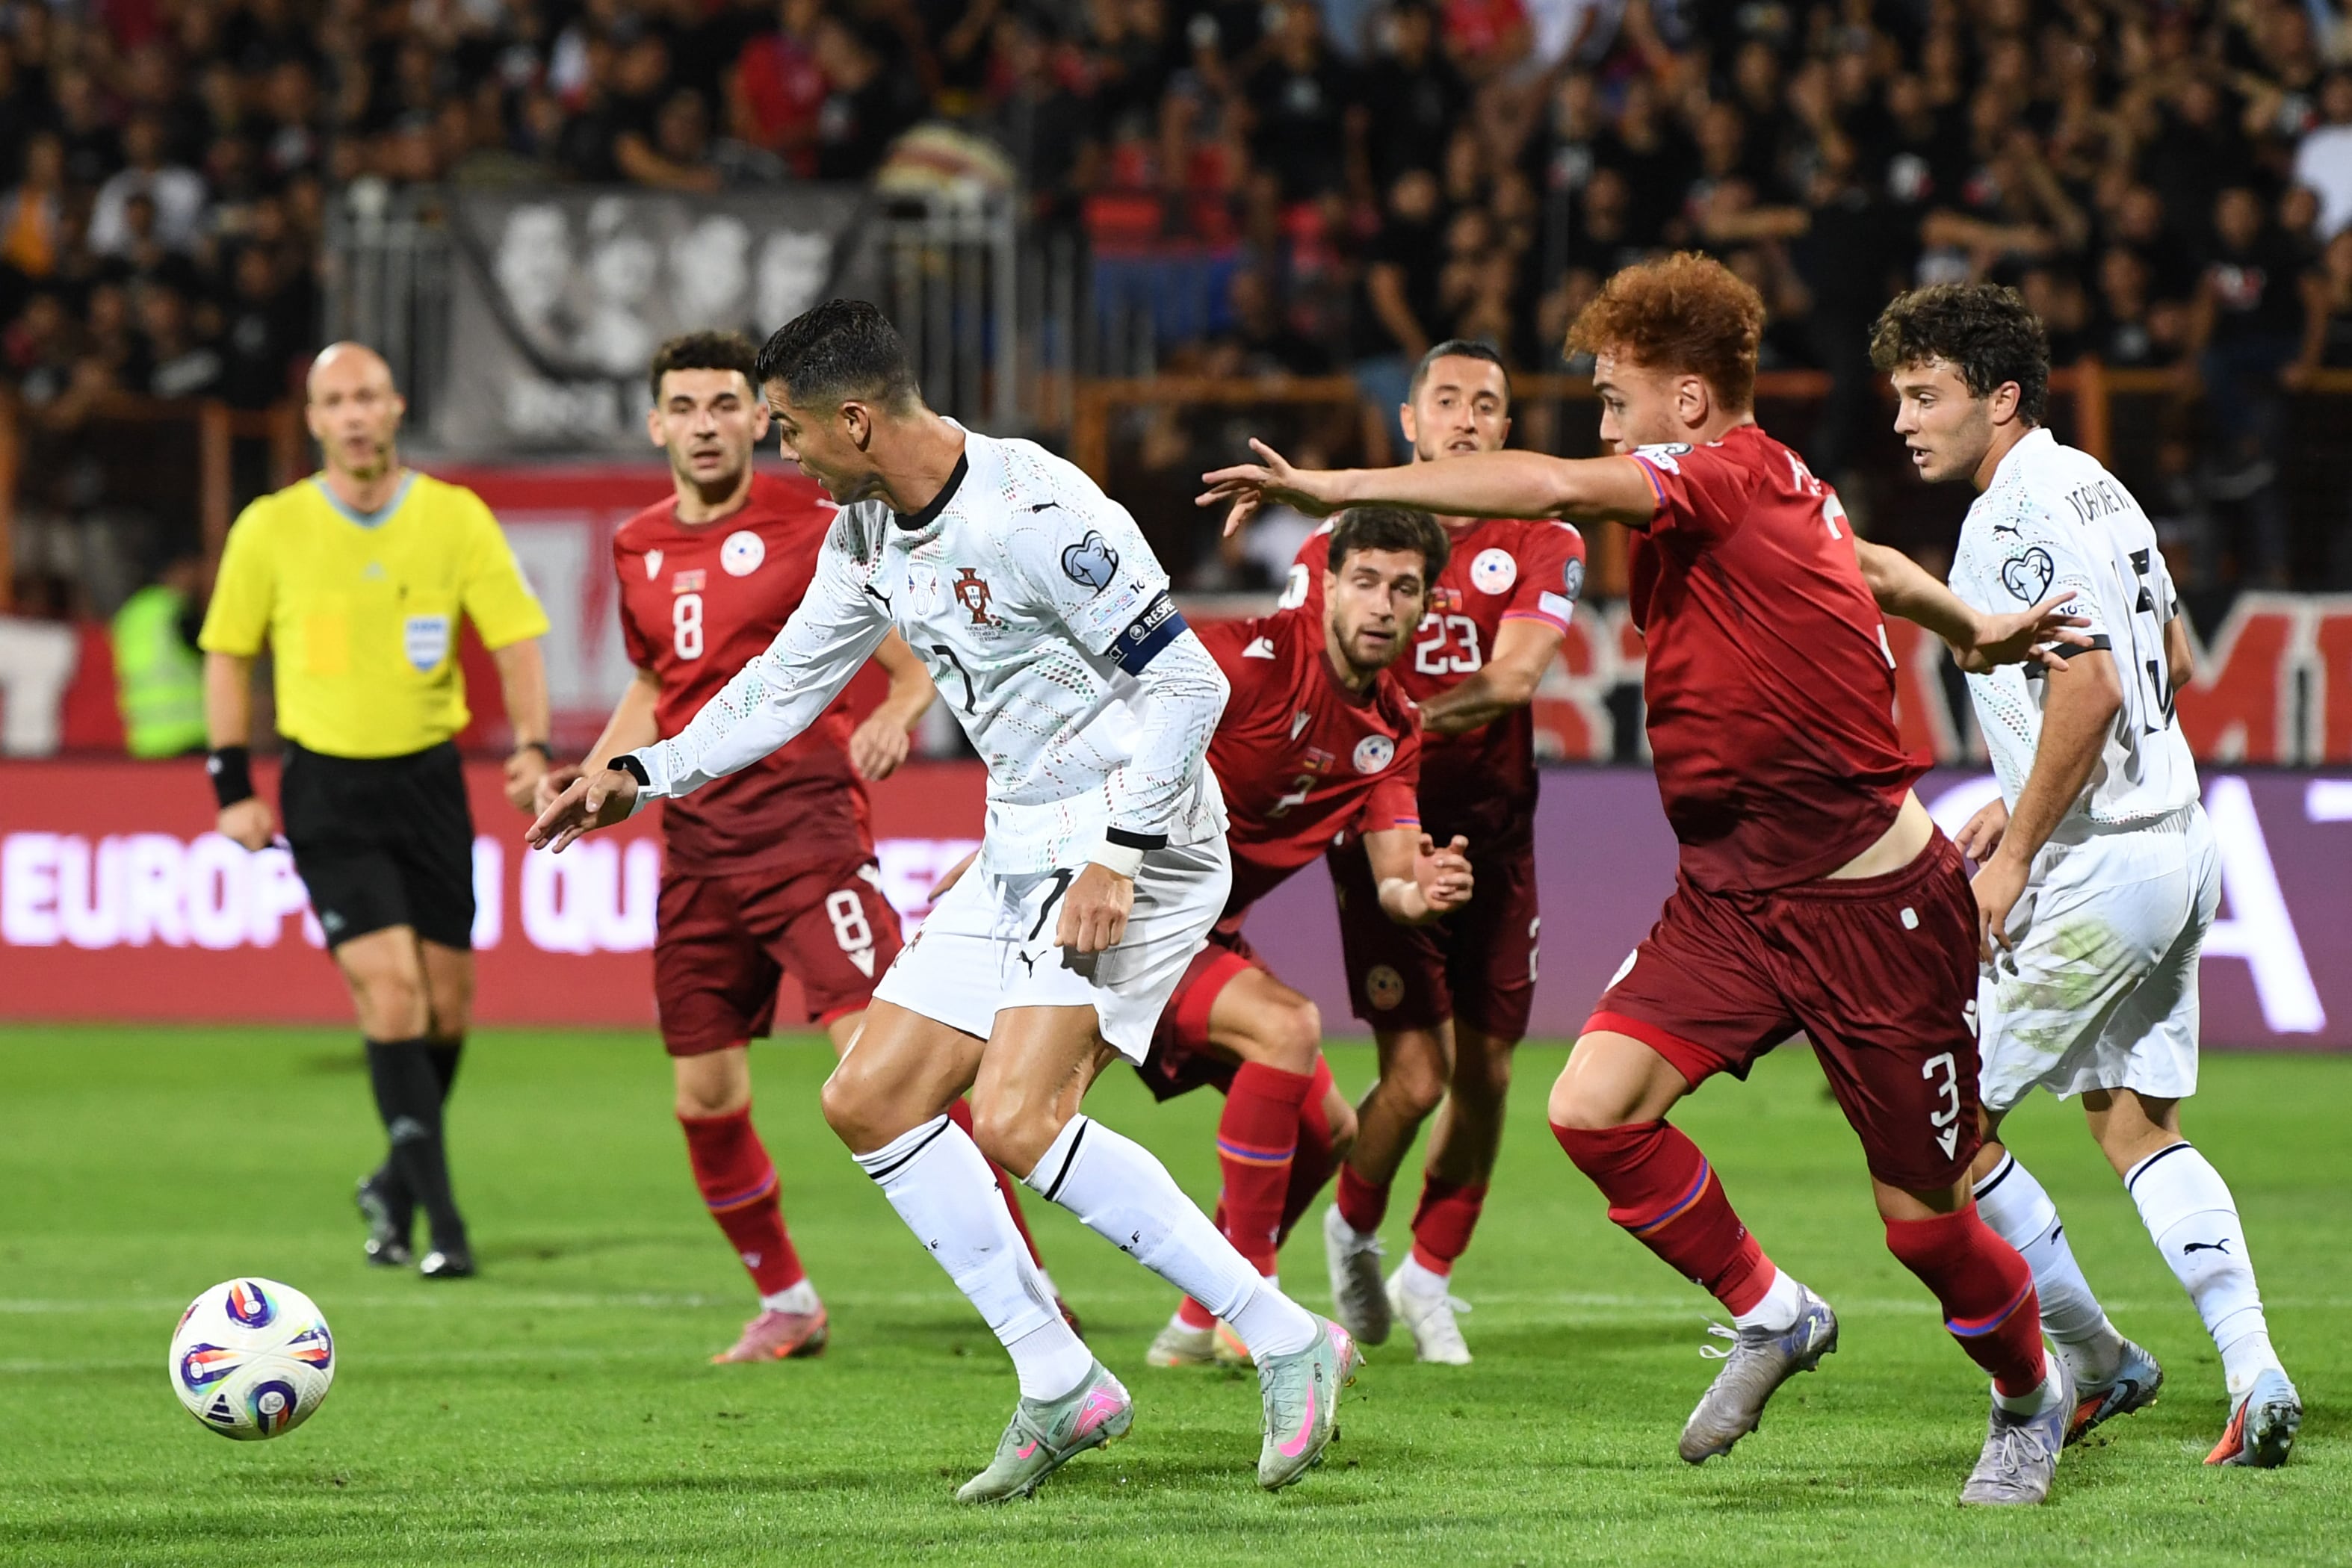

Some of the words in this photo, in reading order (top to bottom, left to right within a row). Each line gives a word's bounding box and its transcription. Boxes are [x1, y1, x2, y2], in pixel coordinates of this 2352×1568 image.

[673, 593, 704, 660] 8
[1416, 613, 1482, 675] 23
[931, 645, 976, 714] 7
[1266, 774, 1318, 819] 2
[1, 831, 503, 950] EUROP
[826, 890, 873, 952] 8
[1028, 867, 1074, 941] 7
[1922, 1051, 1961, 1128] 3
